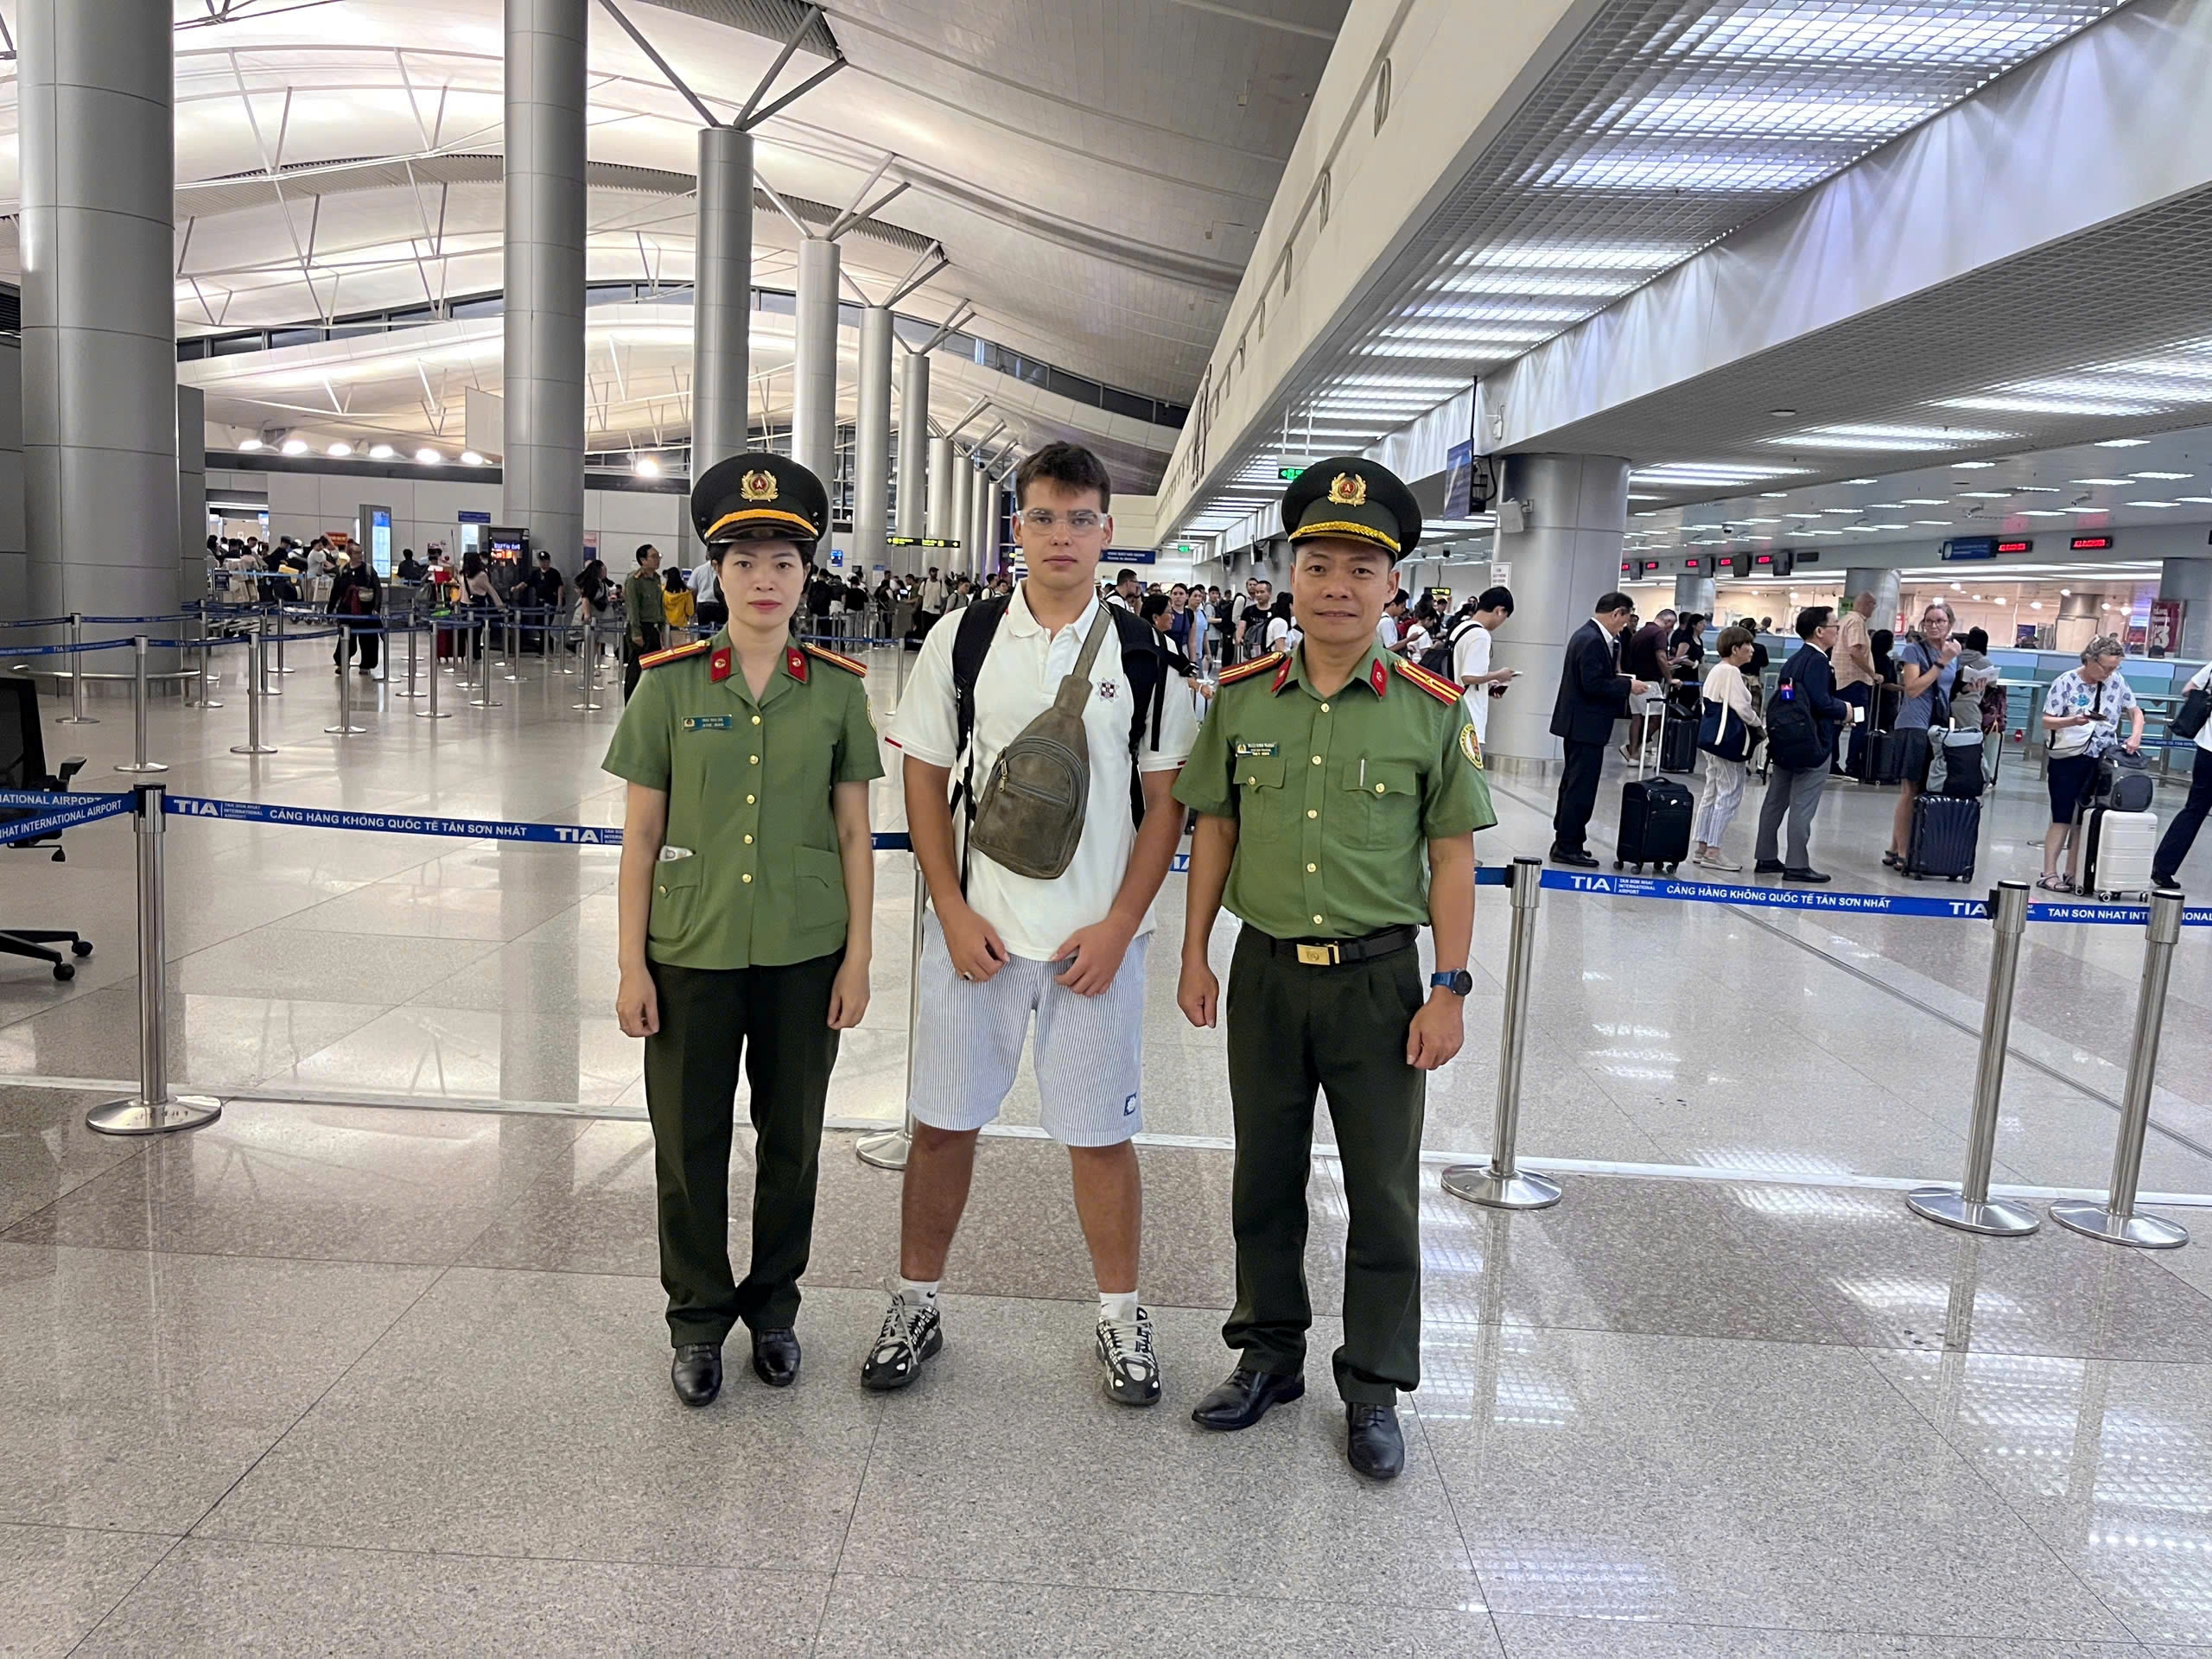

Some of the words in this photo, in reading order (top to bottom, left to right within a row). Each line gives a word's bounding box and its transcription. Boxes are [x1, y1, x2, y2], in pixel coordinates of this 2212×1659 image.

[52, 796, 102, 805] AIRPOR
[174, 799, 219, 816] TIA
[21, 810, 86, 833] INTERNATIONAL
[87, 800, 122, 817] AIRPORT
[554, 828, 599, 843] TIA
[1571, 875, 1611, 891] TIA
[1667, 882, 1695, 895] CẢNG
[1698, 885, 1727, 898] HÀNG
[1730, 888, 1766, 900] KHÔNG
[1769, 891, 1798, 903] QUỐC
[1801, 893, 1814, 904] TẾ
[1815, 894, 1836, 906] TÂN
[1839, 897, 1861, 907] SƠN
[1863, 897, 1891, 908] NHẤT
[1948, 902, 1987, 916] TIA
[2048, 908, 2069, 918] TAN
[2071, 909, 2095, 918] SON
[2097, 910, 2127, 920] NHAT
